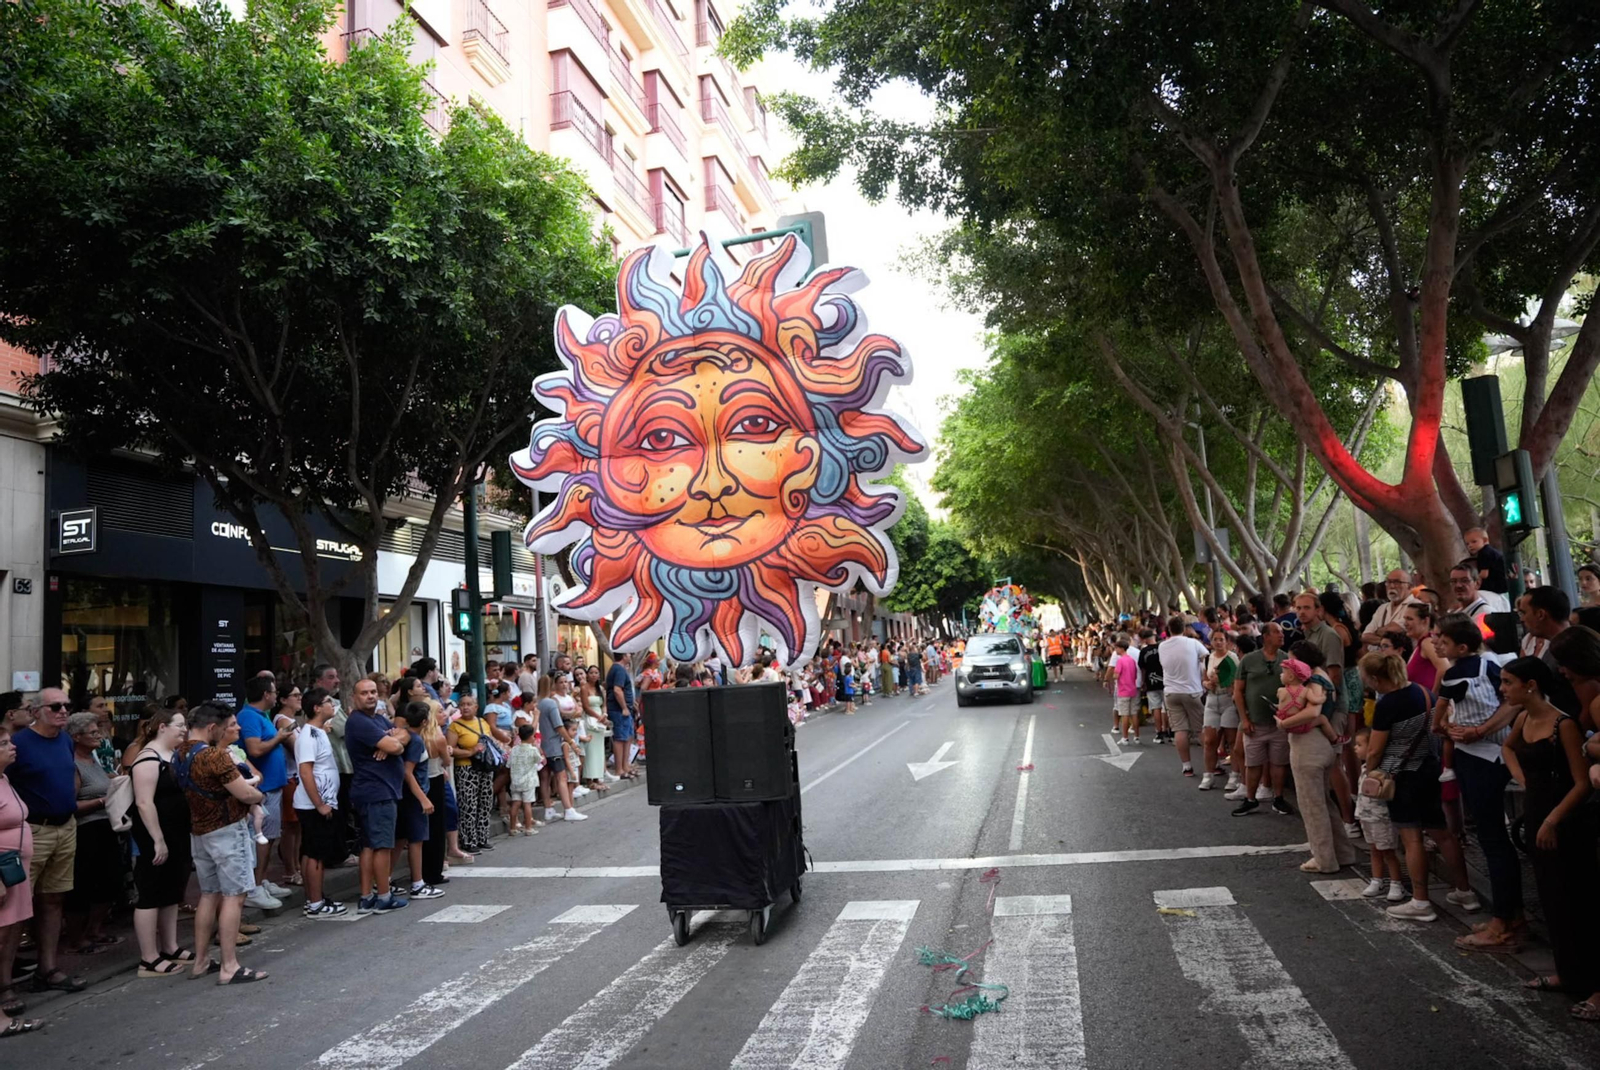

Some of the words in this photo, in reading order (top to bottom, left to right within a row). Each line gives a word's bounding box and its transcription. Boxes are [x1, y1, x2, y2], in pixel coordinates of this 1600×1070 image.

[63, 518, 91, 536] ST
[63, 537, 90, 545] STRUGAL
[316, 539, 363, 556] STRUGAL
[15, 578, 31, 593] 63
[218, 620, 229, 628] ST
